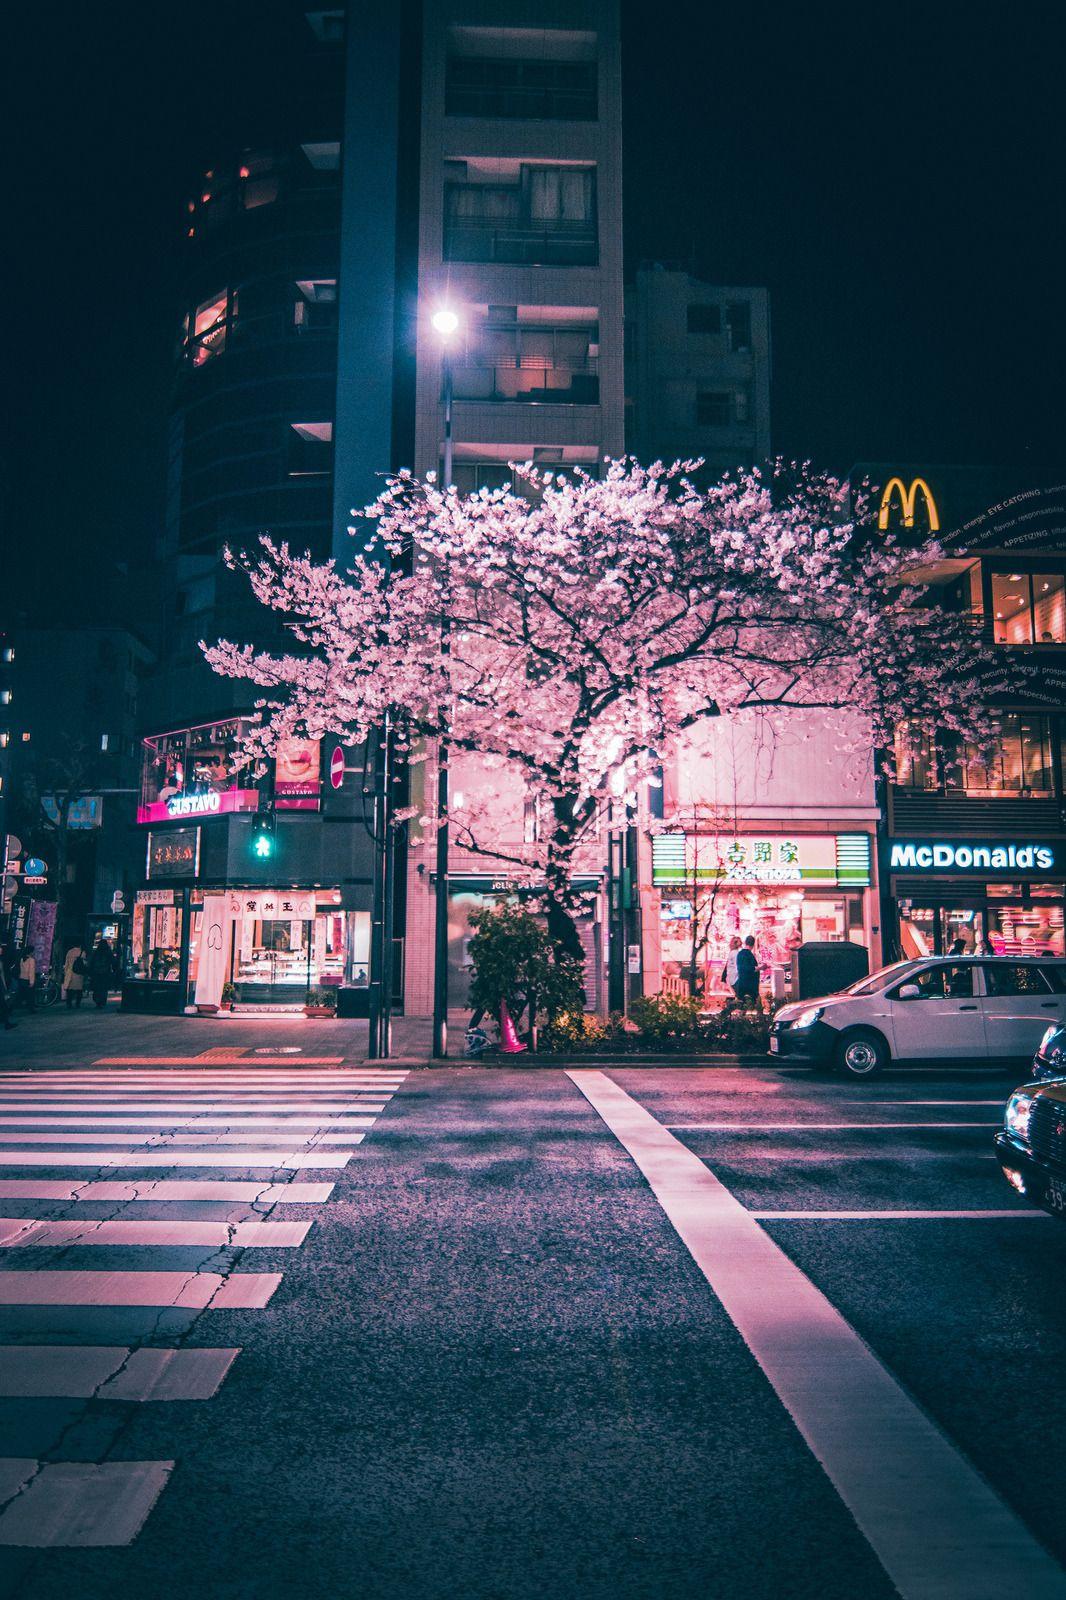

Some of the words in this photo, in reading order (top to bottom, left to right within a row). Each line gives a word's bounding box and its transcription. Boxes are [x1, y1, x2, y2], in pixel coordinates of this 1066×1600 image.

[987, 504, 1003, 516] EYE
[168, 793, 220, 815] GUSTAVO
[727, 841, 799, 864] 吉野家
[891, 844, 1054, 868] McDonald's
